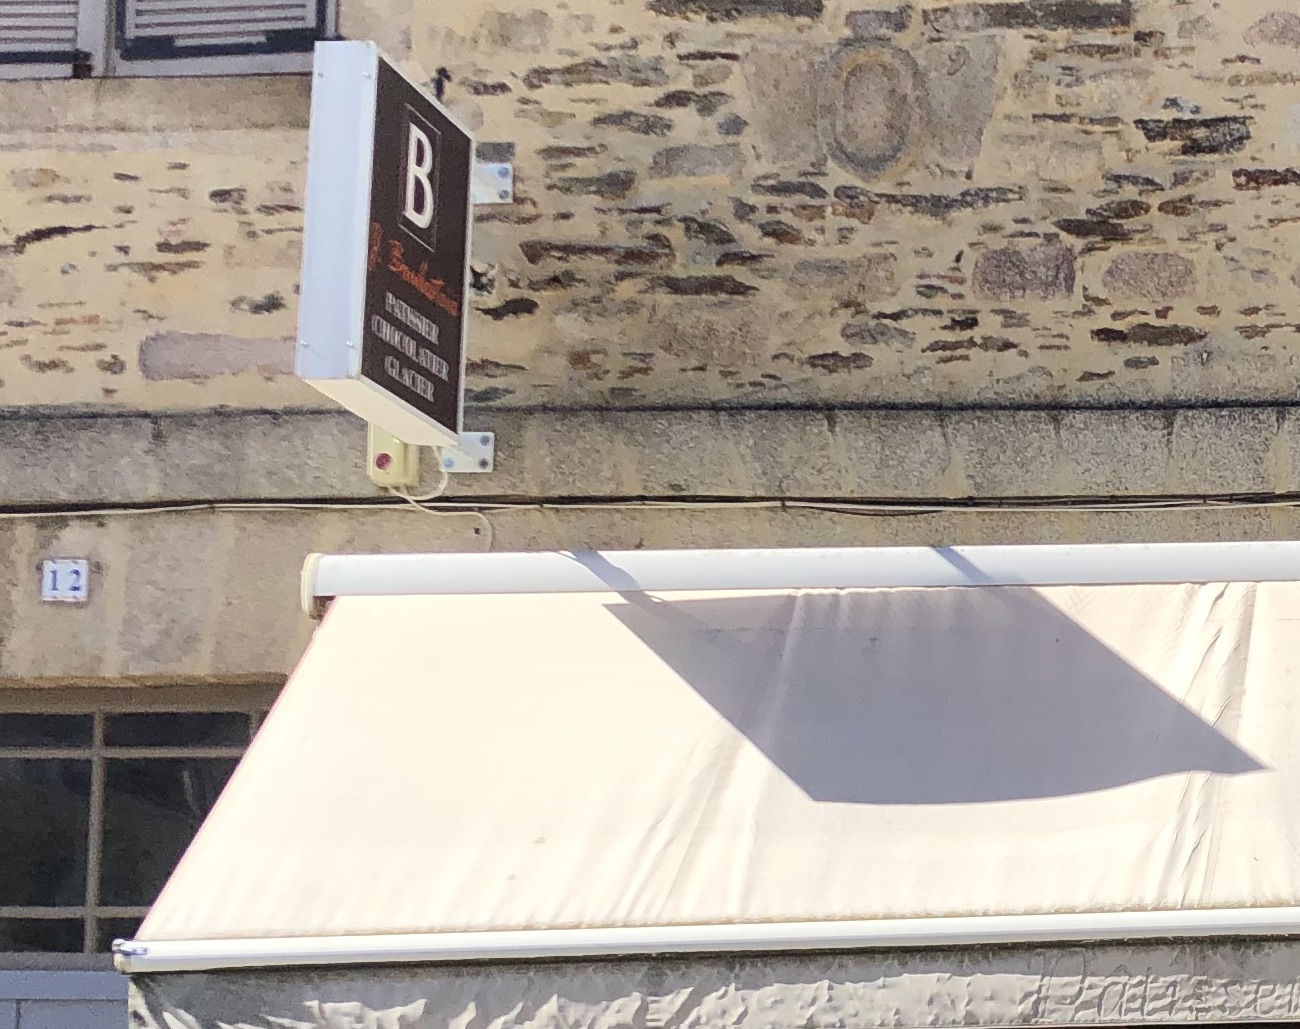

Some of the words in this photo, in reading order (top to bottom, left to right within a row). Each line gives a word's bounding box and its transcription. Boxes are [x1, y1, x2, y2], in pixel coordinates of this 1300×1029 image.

[401, 122, 434, 230] B
[371, 314, 449, 382] CHOCOLATIER
[384, 355, 435, 402] GLACIER
[50, 569, 82, 592] 12
